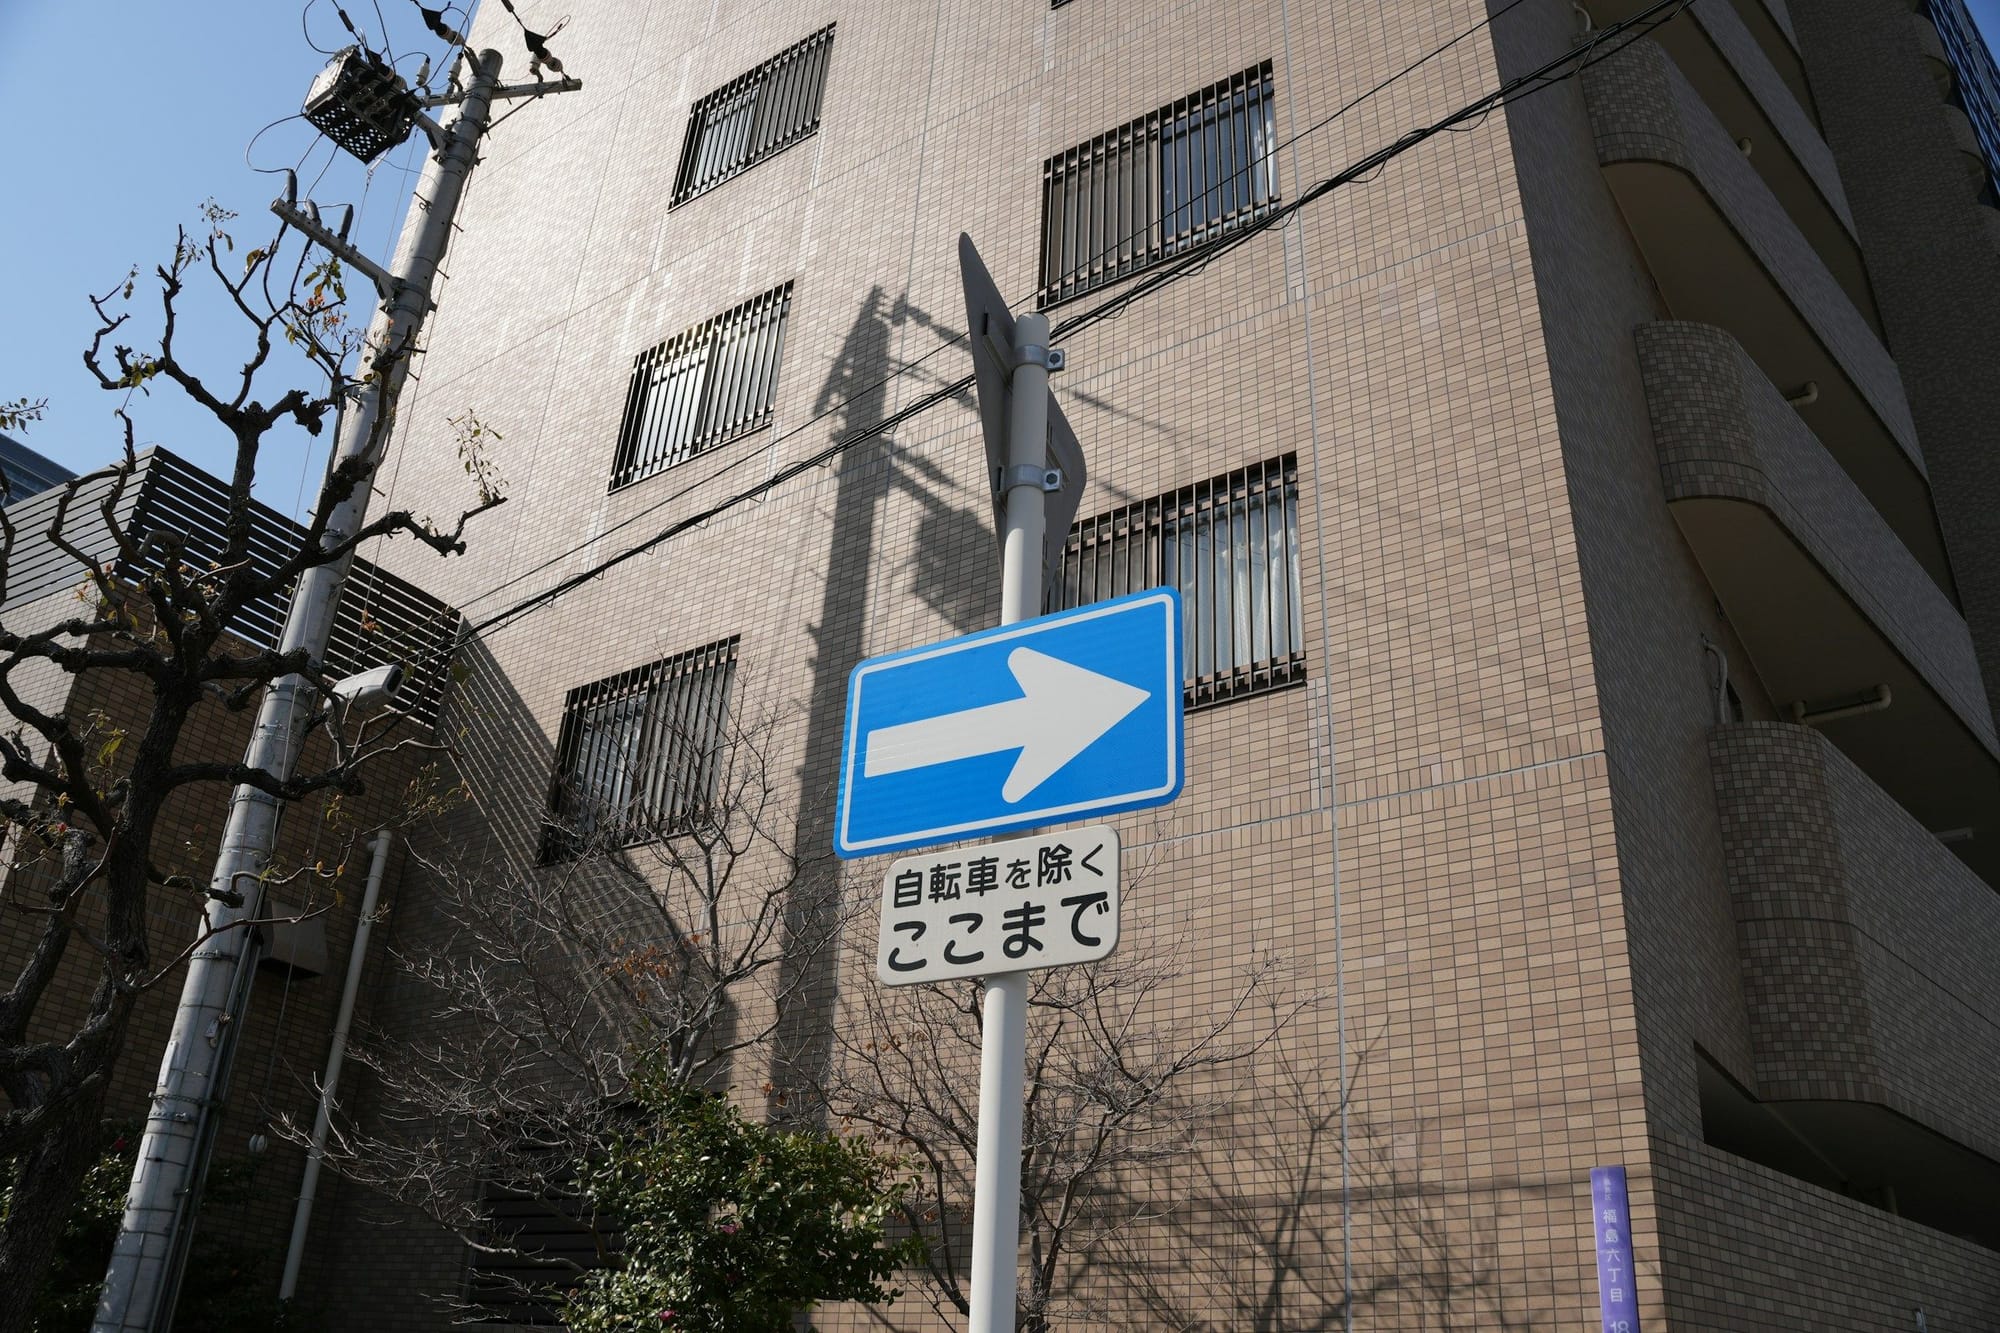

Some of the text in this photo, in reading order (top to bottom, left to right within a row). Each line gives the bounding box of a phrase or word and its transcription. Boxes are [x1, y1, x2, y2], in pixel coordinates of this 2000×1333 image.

[894, 843, 1103, 908] 自転車を除く
[888, 891, 1110, 972] ここまで
[1603, 1209, 1623, 1302] 福島六丁目
